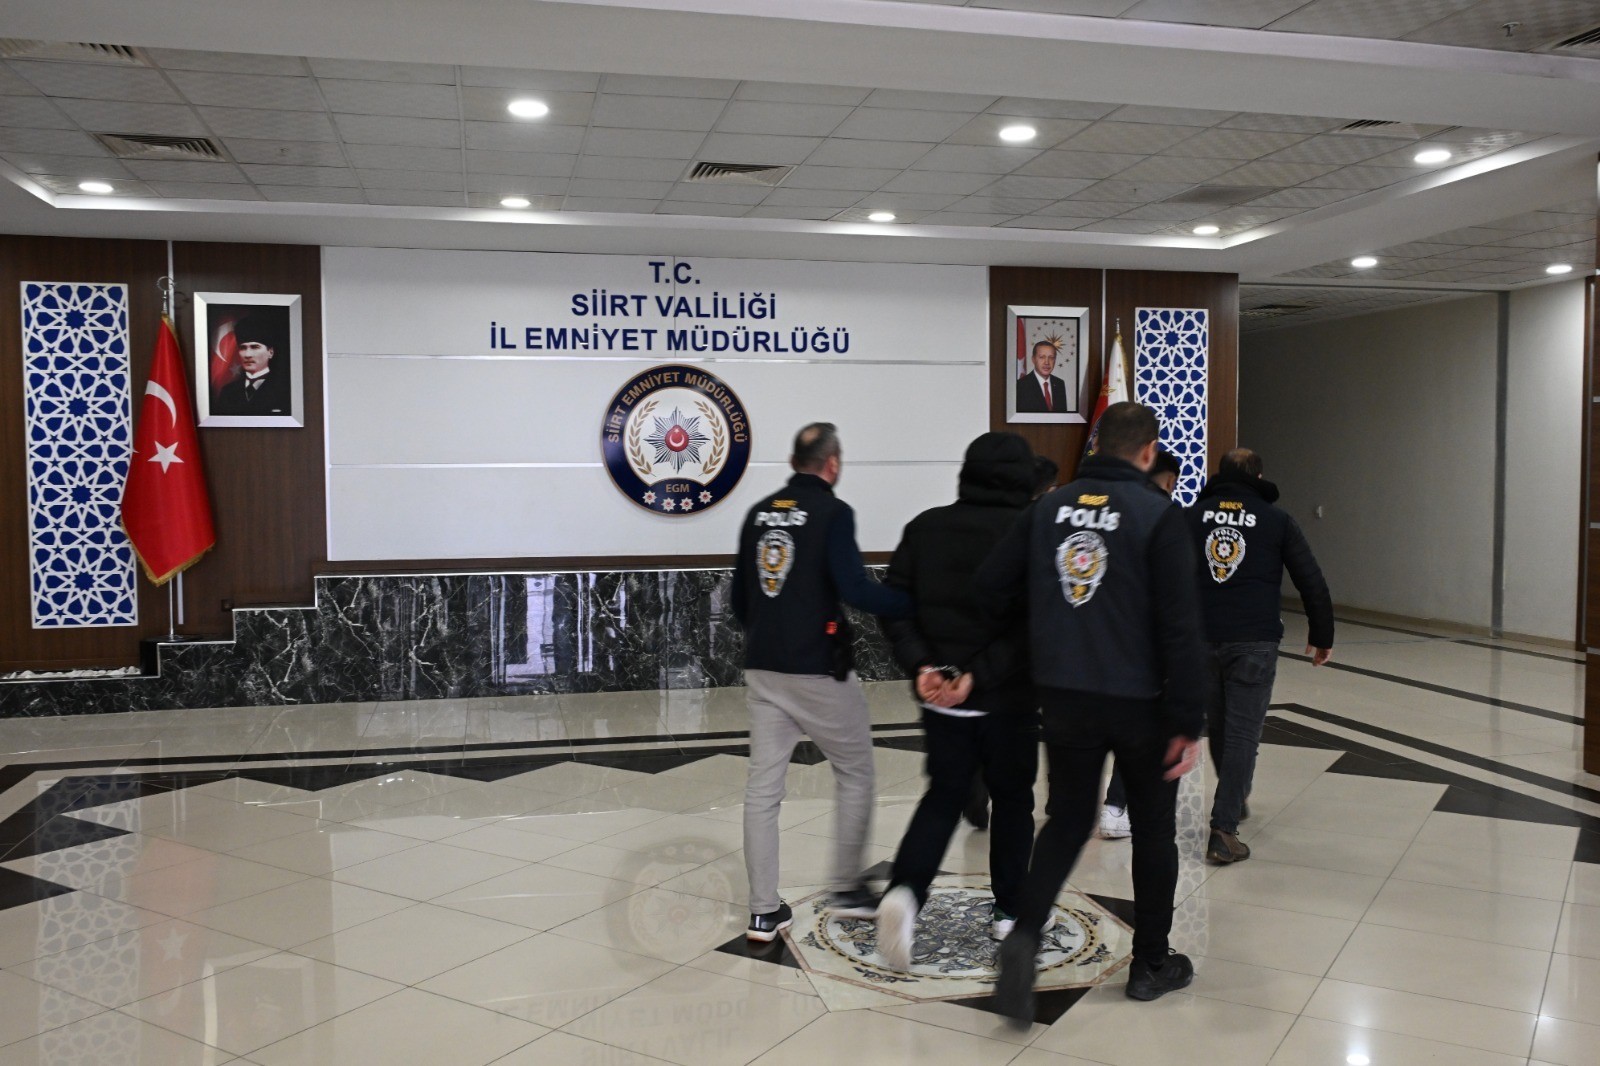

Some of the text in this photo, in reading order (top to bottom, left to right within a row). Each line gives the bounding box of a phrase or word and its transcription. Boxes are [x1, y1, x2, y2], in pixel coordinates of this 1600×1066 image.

[648, 262, 701, 285] T.C.
[571, 289, 777, 320] SİİRT VALİLİĞİ
[490, 322, 850, 354] İL EMNİYET MÜDÜRLÜĞÜ
[605, 371, 748, 443] SİİRT EMNİYET MÜDÜRLÜĞÜ
[665, 483, 690, 493] EGM
[1202, 509, 1257, 528] POLİS
